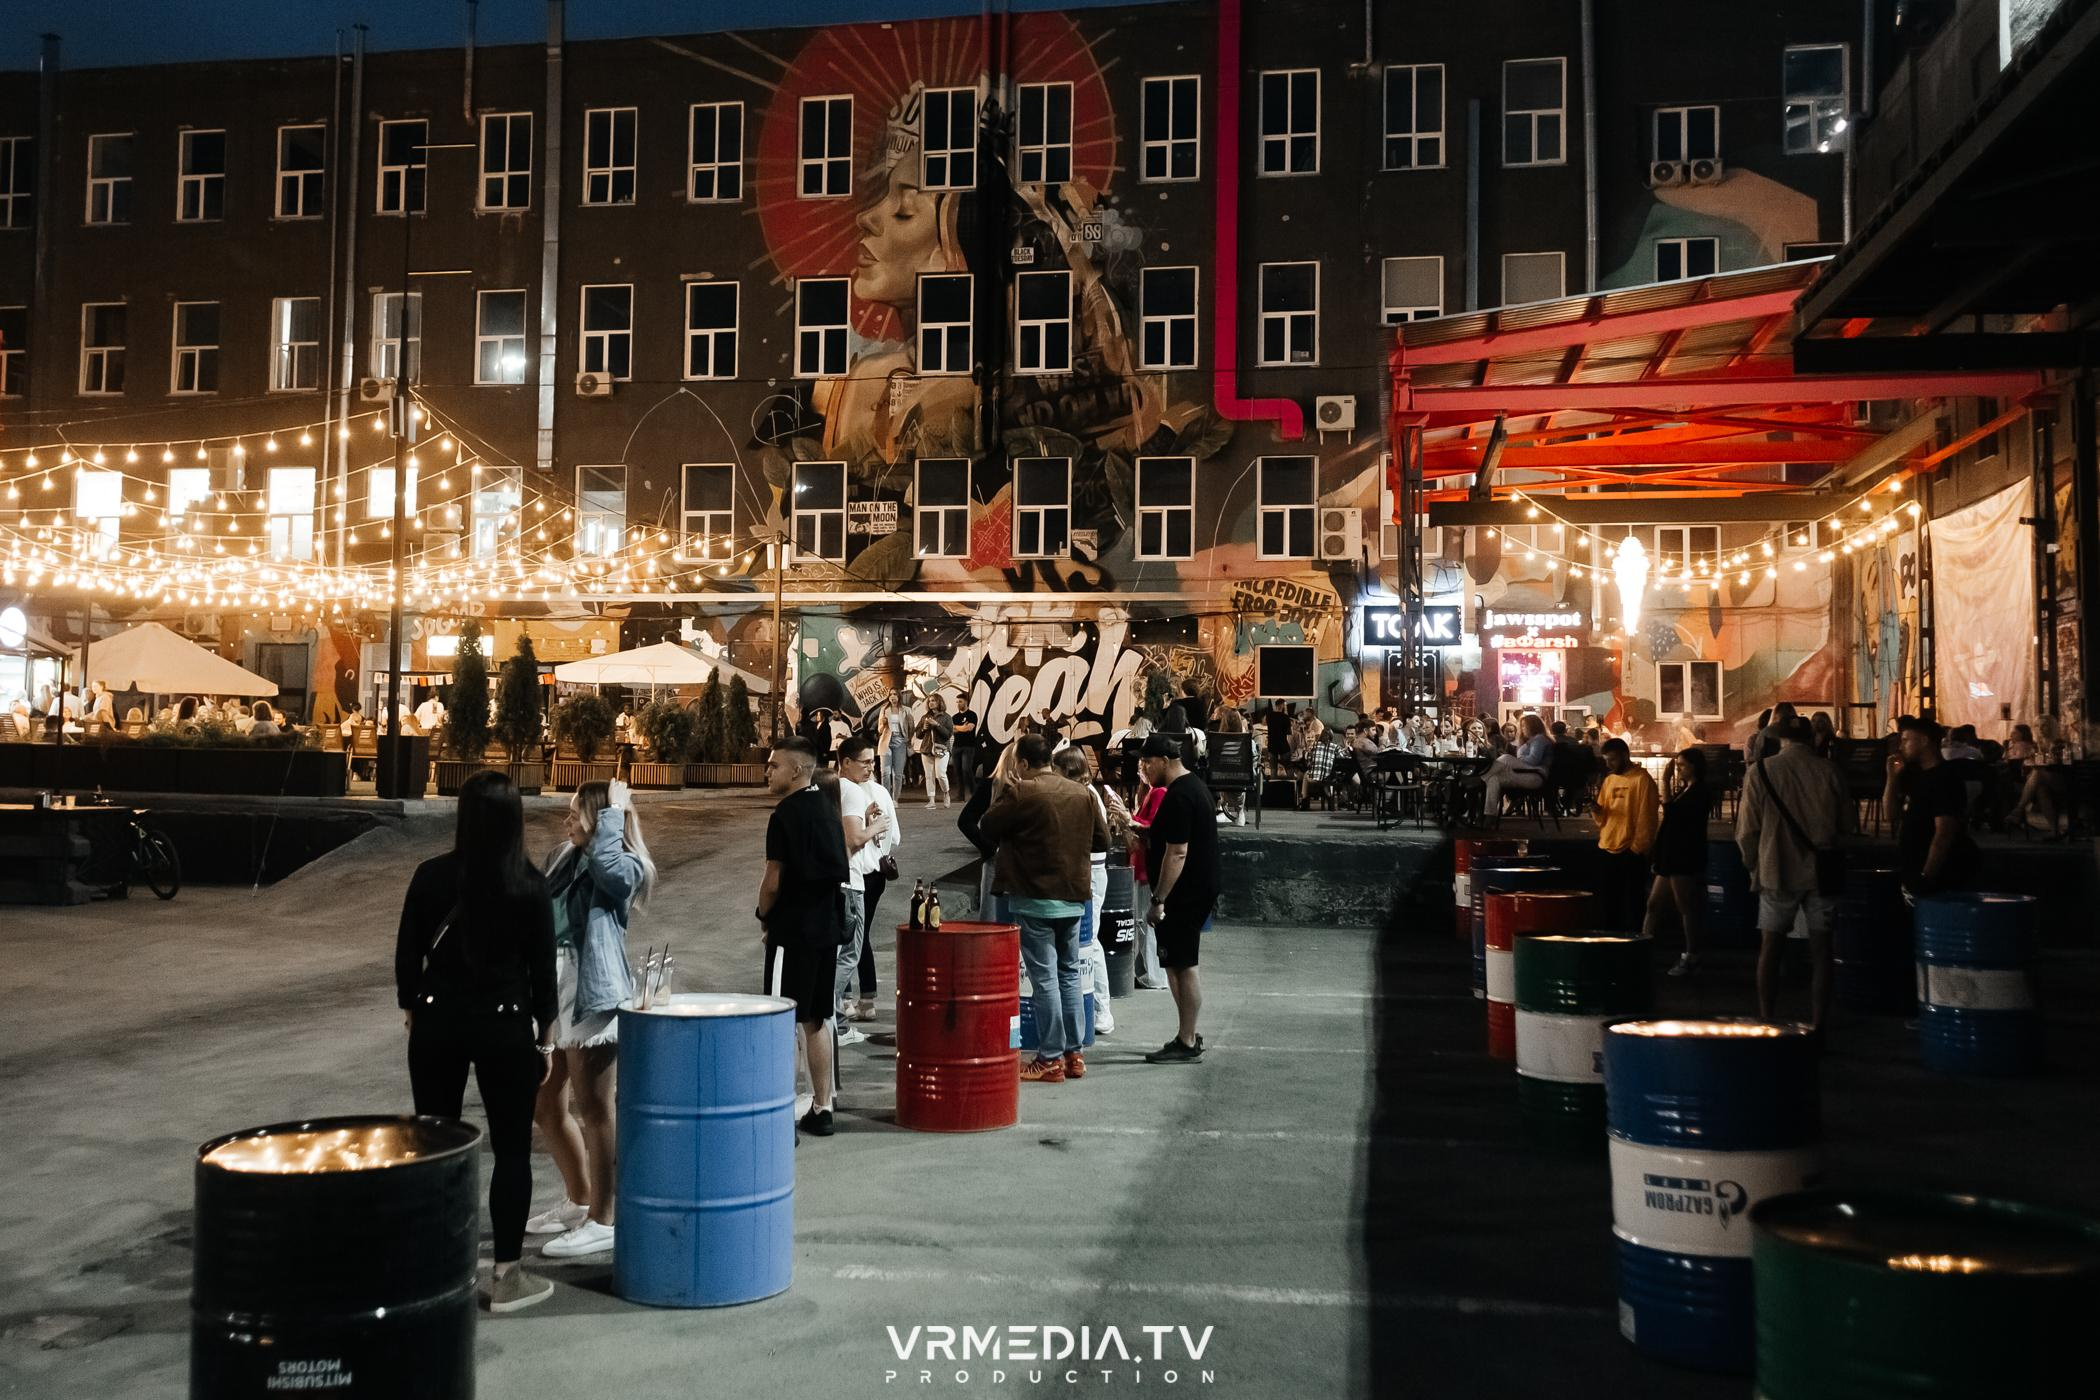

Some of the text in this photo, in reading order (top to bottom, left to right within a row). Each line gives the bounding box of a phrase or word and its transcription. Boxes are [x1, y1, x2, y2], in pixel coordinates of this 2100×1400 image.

[850, 502, 896, 512] MAN ON THE
[873, 512, 896, 522] MOON
[1483, 609, 1581, 630] jawsspot
[856, 680, 881, 701] WHO IS
[861, 694, 879, 708] JACK
[1645, 1190, 1713, 1214] GAZPROM
[278, 1358, 341, 1374] MOTORS
[267, 1372, 352, 1389] MITSUBISHI
